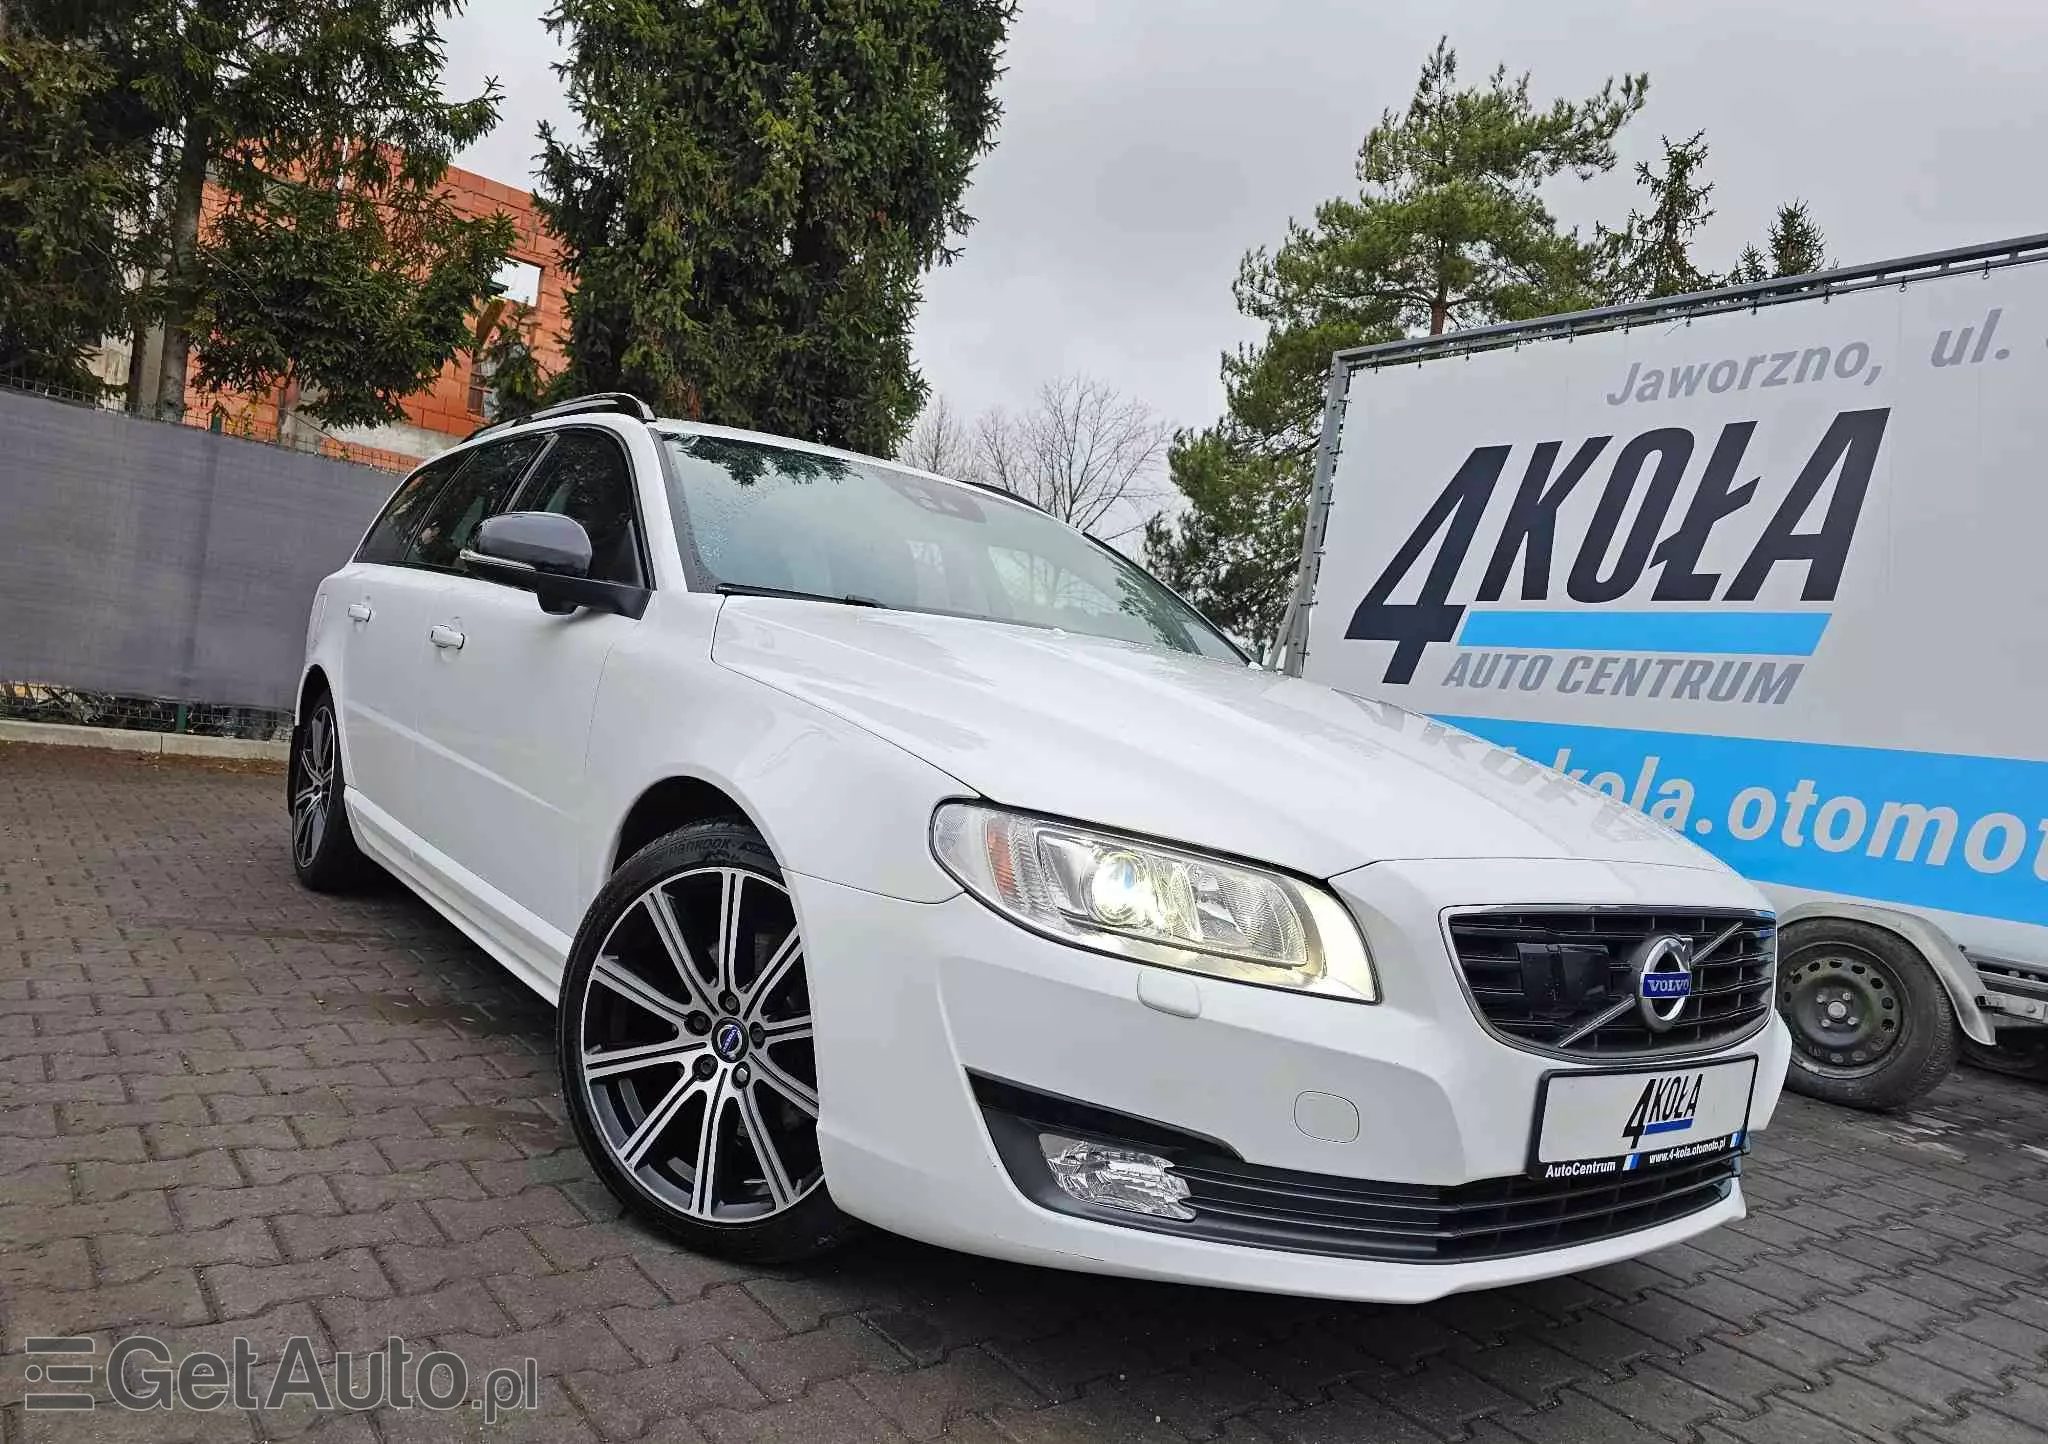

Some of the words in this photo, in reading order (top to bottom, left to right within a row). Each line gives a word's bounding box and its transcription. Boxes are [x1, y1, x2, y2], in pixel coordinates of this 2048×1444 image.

[1607, 340, 1882, 407] Jaworzno,
[1930, 307, 2011, 368] ul.
[1442, 652, 1553, 693] AUTO
[1556, 656, 1805, 706] CENTRUM
[1647, 979, 1690, 993] VOLVO
[1545, 1160, 1616, 1179] AutoCentrum
